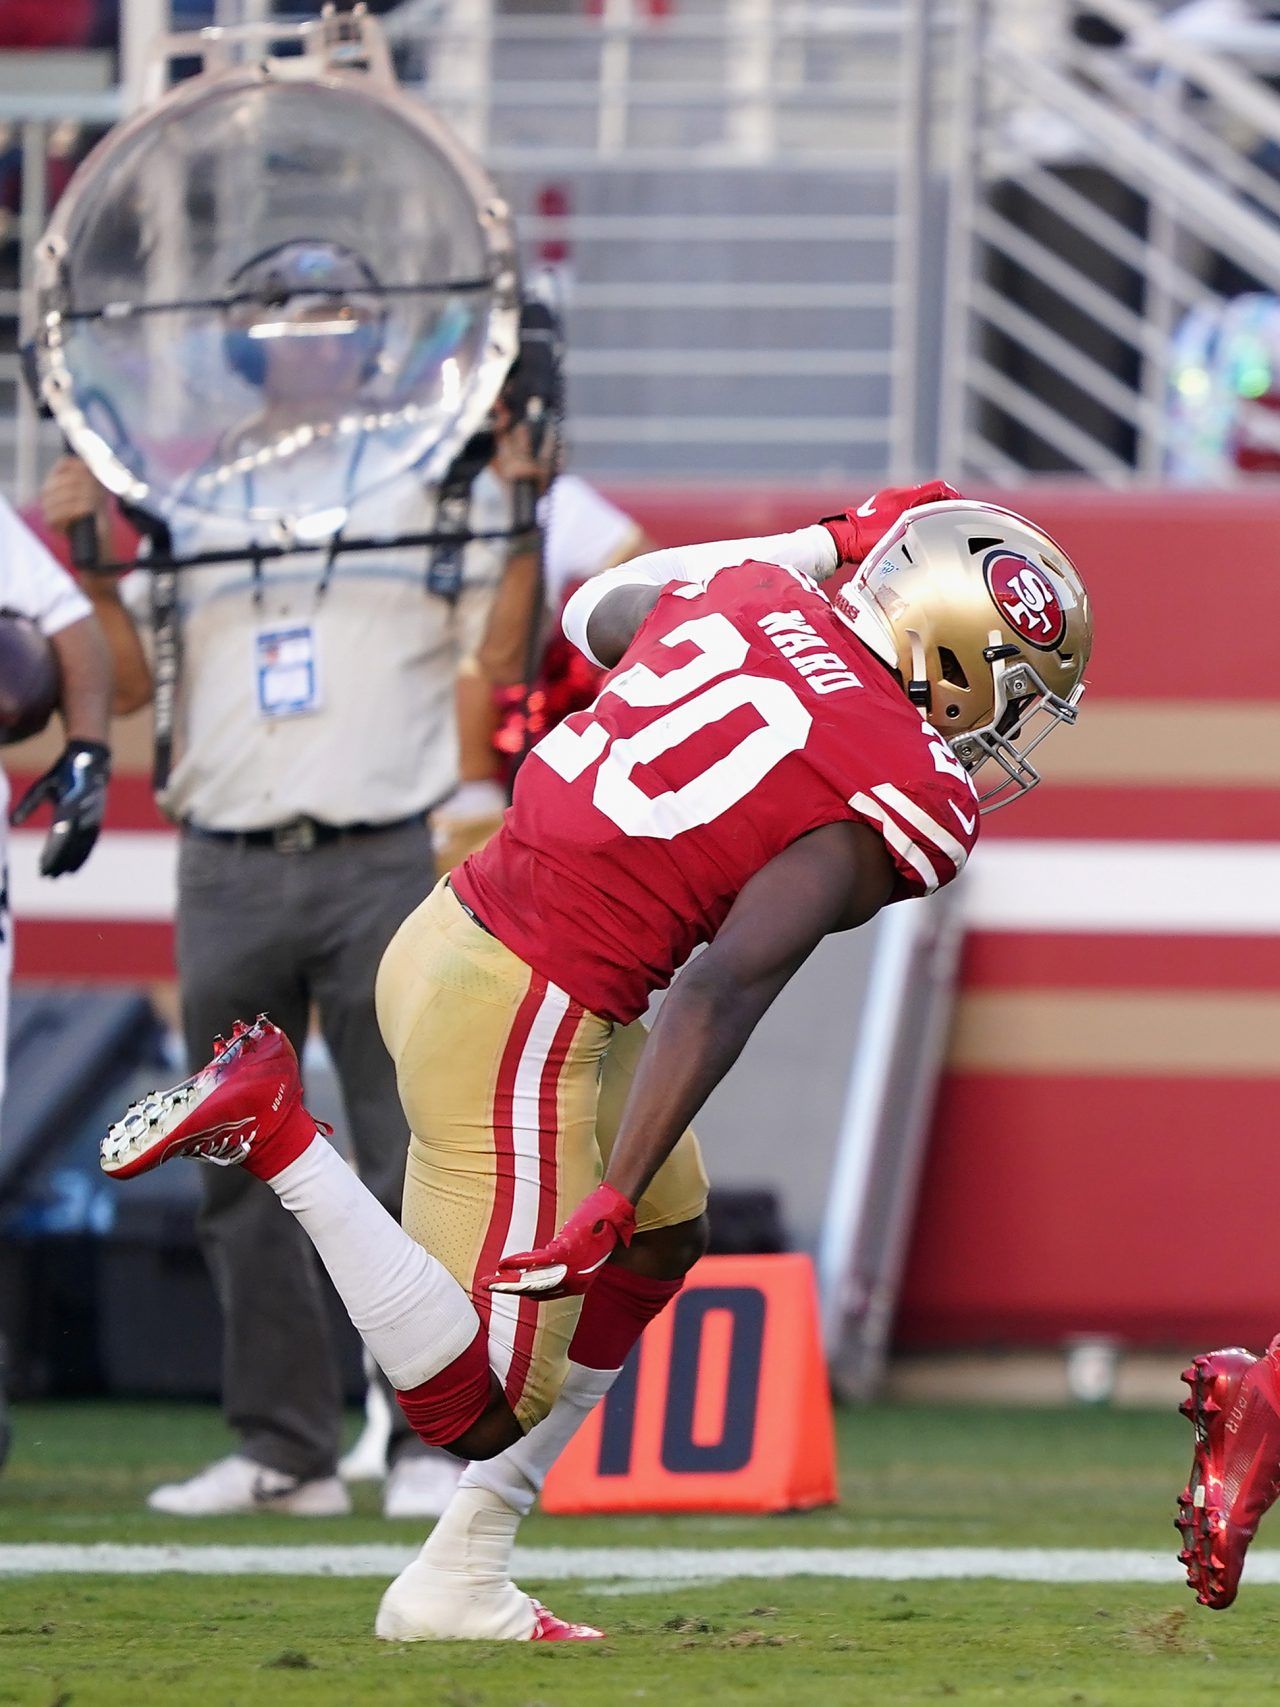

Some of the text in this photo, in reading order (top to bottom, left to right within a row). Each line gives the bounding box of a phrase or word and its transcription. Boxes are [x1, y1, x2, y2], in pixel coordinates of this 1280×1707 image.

[757, 609, 864, 695] WARD
[531, 612, 814, 840] 20
[921, 720, 979, 802] 2
[271, 1082, 286, 1112] VAPOR
[596, 1286, 767, 1477] 10
